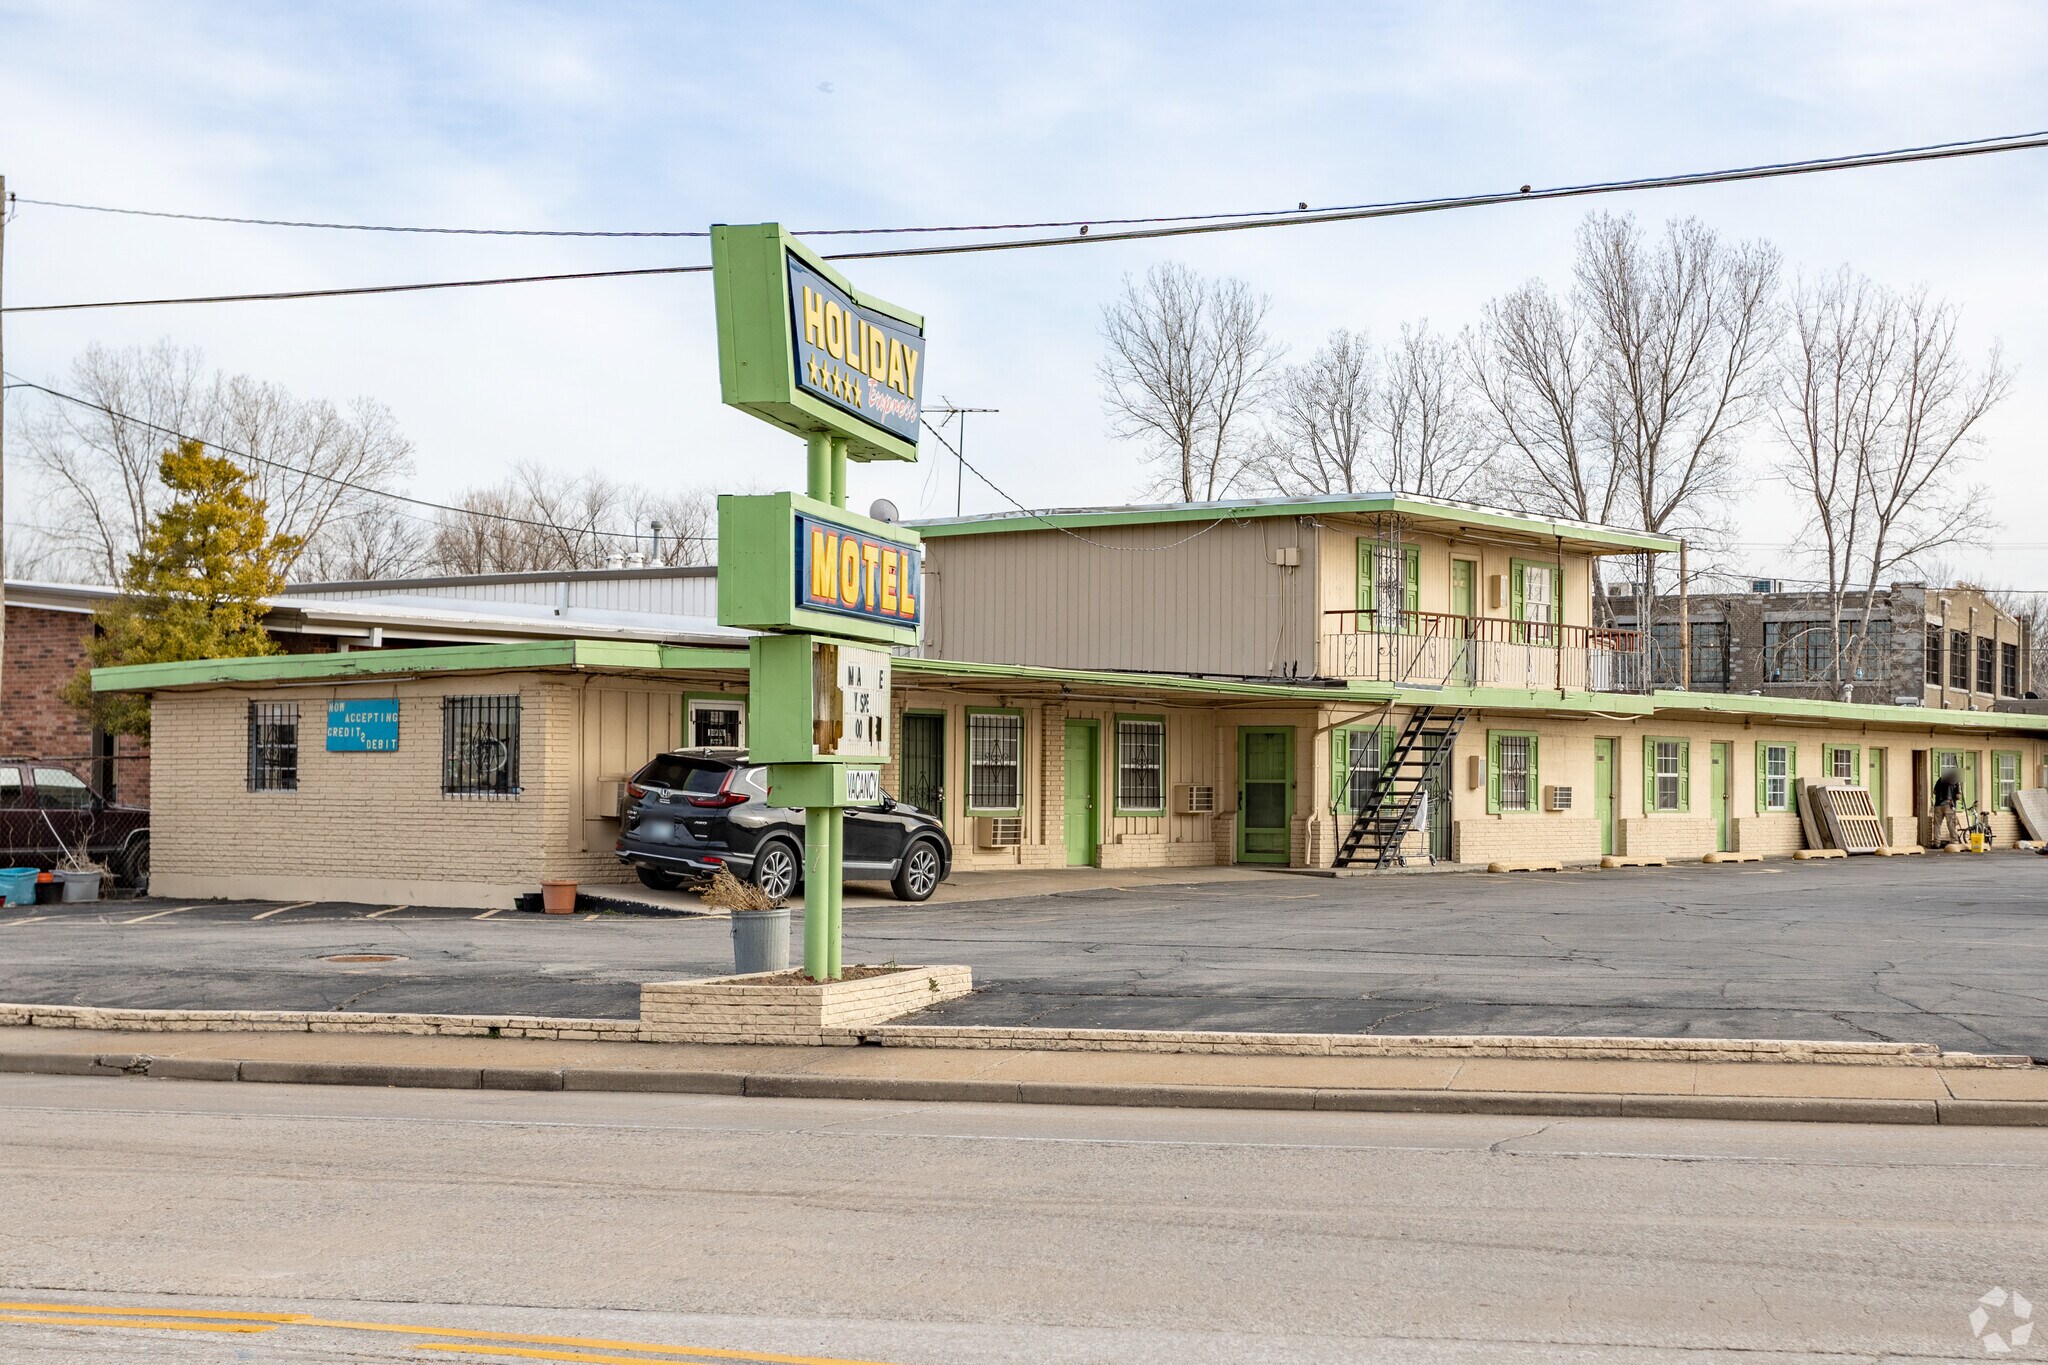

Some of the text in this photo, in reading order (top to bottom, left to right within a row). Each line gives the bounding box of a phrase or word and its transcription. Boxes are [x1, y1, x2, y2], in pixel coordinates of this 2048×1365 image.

[803, 285, 918, 400] HOLIDAY
[811, 526, 915, 619] MOTEL
[328, 702, 345, 712] NOW
[345, 713, 398, 723] ACCEPTING
[327, 727, 361, 737] CREDIT
[366, 739, 397, 749] DEBIT
[847, 771, 878, 800] VACANCY
